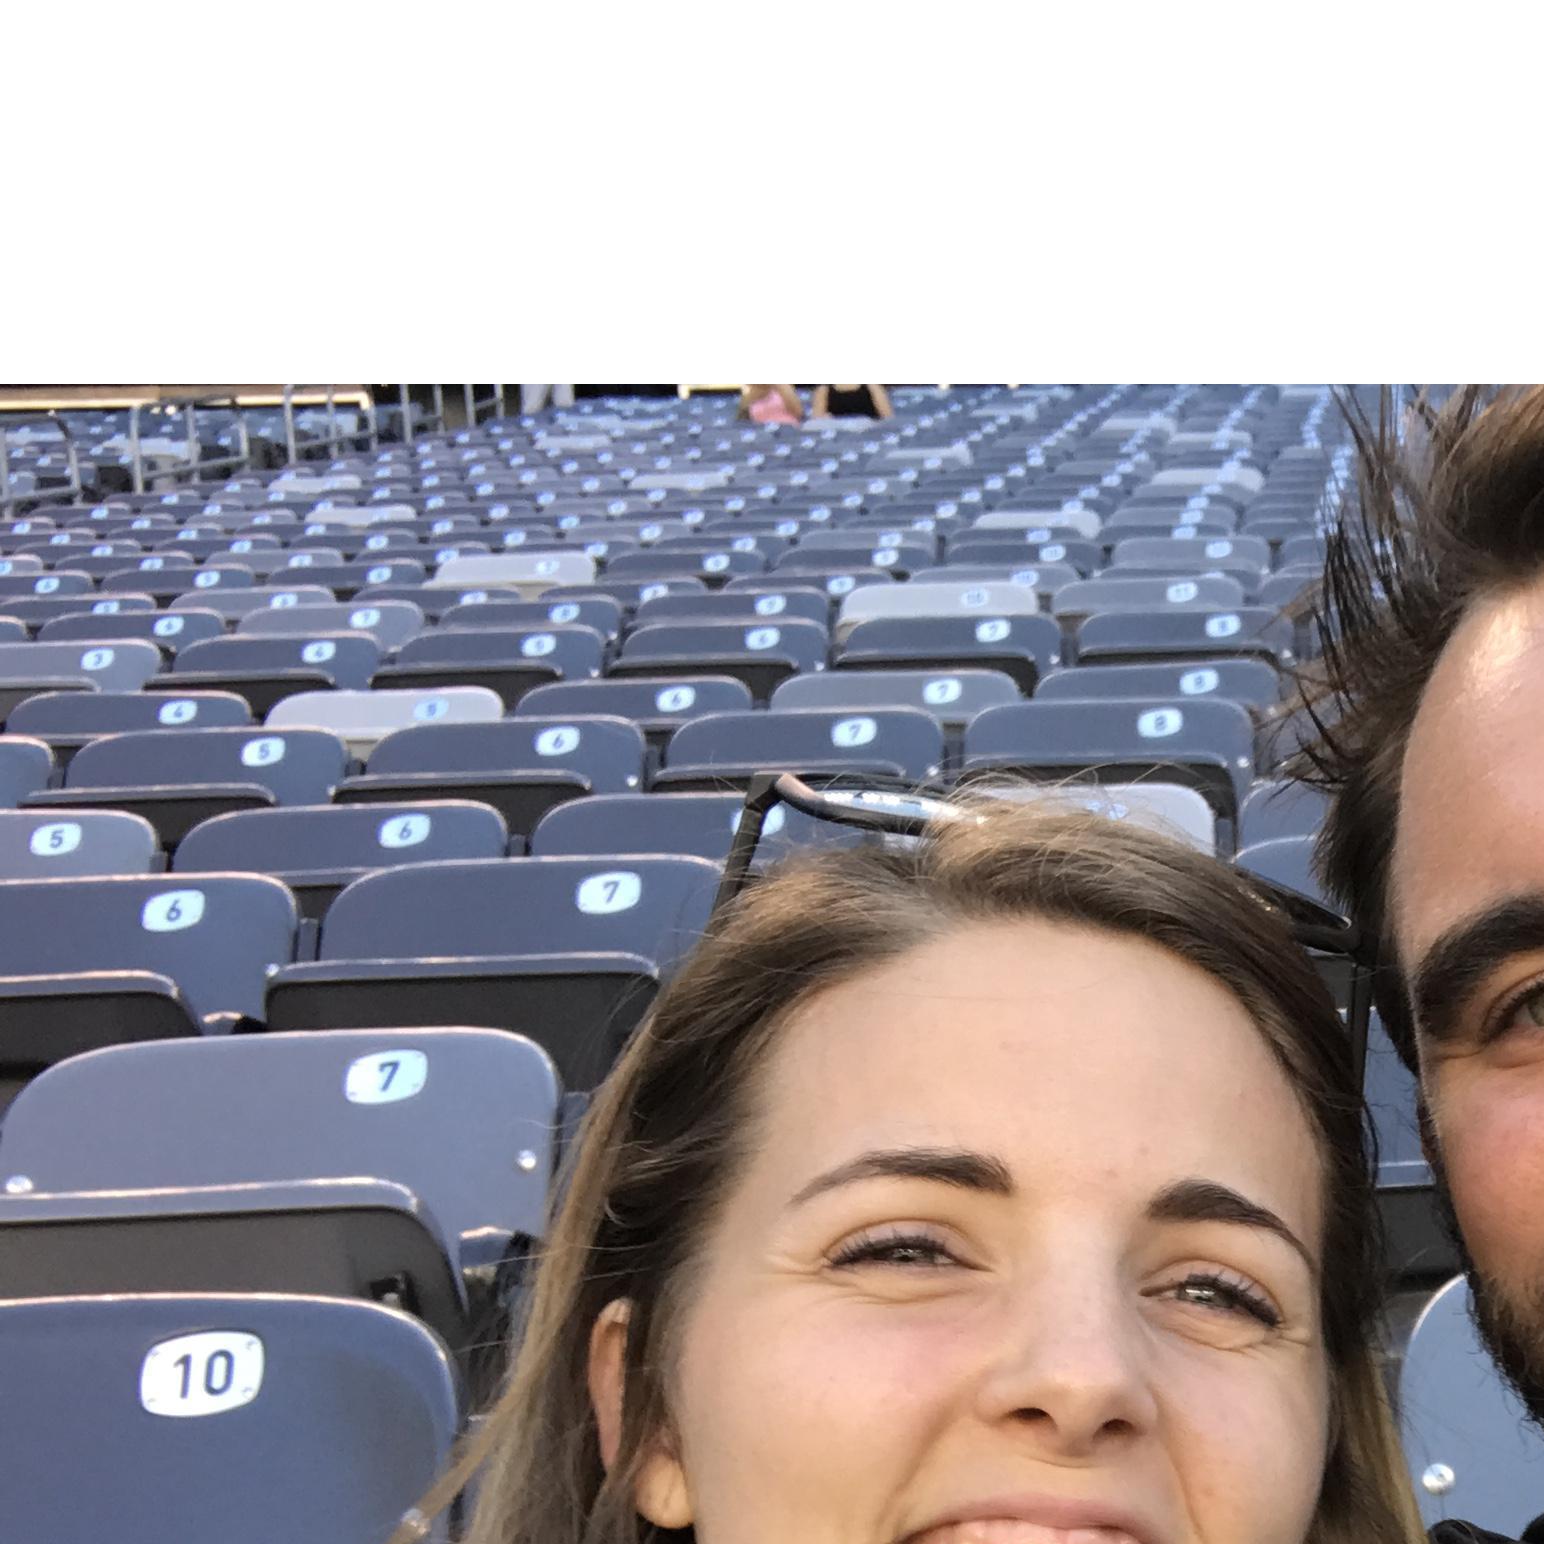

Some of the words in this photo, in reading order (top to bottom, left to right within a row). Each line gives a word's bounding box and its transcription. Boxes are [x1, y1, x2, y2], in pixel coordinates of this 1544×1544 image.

[937, 684, 948, 699] 7
[553, 733, 564, 749] 6
[848, 723, 861, 741] 7
[50, 829, 64, 849] 5
[399, 822, 412, 840] 6
[603, 880, 620, 904] 7
[166, 899, 182, 923] 6
[378, 1060, 401, 1092] 7
[174, 1349, 235, 1399] 10
